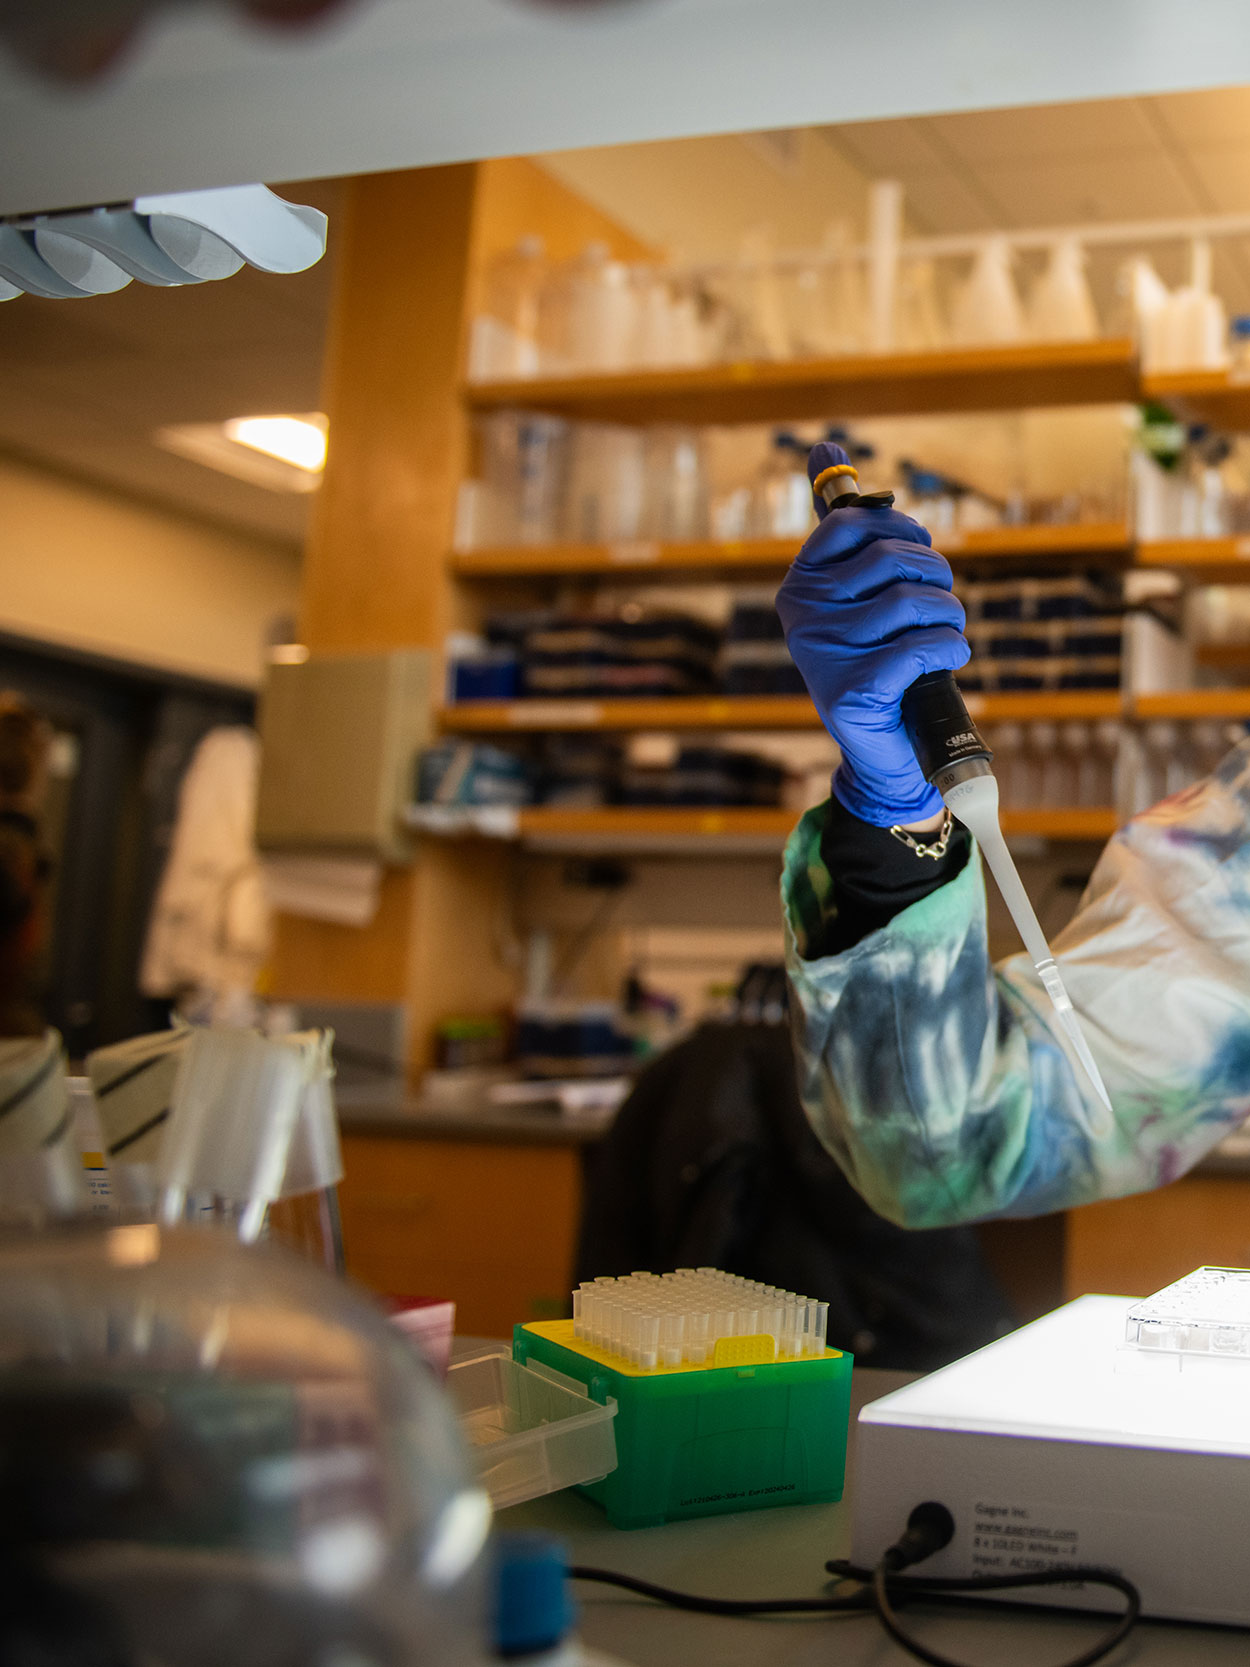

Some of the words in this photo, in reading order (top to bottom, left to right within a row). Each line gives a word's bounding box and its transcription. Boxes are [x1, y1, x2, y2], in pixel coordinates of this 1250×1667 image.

[951, 732, 976, 744] USA
[975, 1503, 1009, 1518] Gagne
[1028, 1542, 1059, 1555] White
[972, 1553, 1002, 1566] Input:
